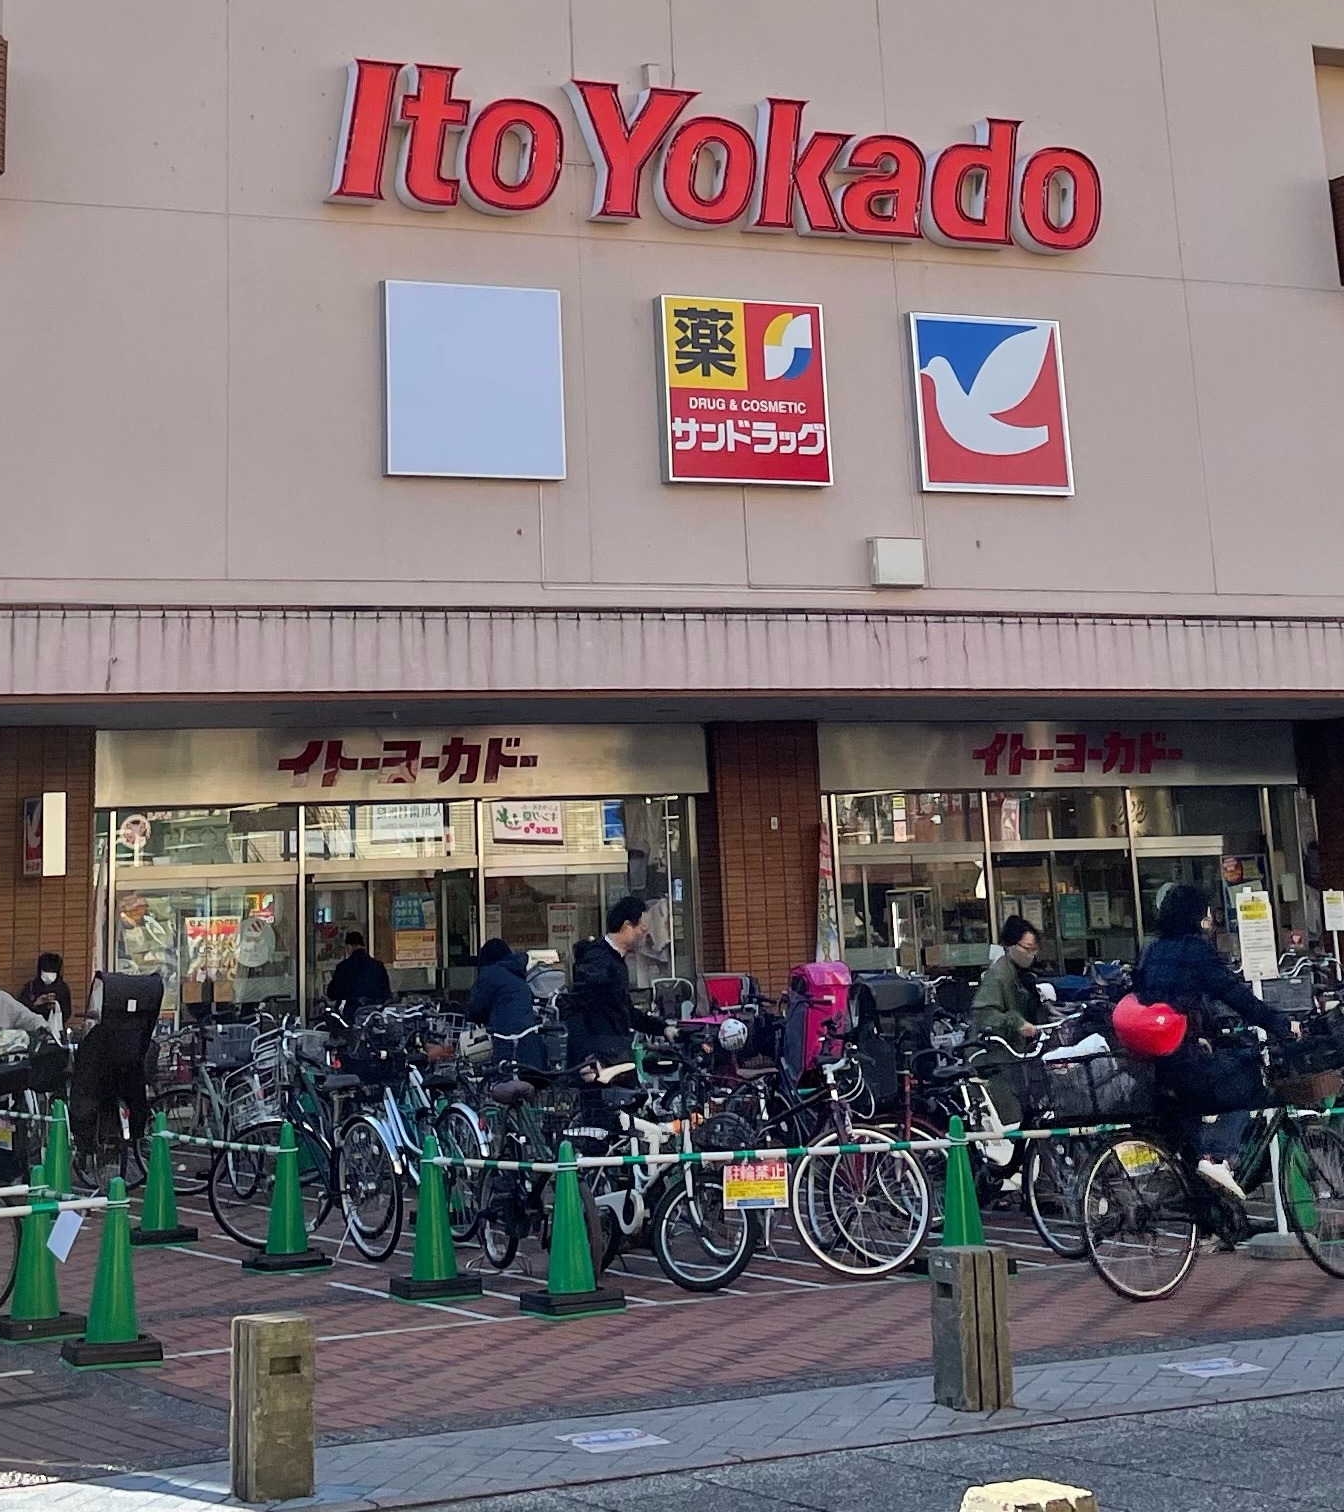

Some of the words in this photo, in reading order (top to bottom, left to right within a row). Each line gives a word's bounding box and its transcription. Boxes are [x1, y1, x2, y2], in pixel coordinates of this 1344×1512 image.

[674, 307, 736, 377] 薬
[689, 397, 726, 411] DRUG
[729, 399, 738, 411] &
[741, 399, 807, 414] COSMETIC
[672, 417, 825, 456] サンドラッグ
[278, 737, 538, 787] イトーヨーカドー
[973, 733, 1182, 775] イトーヨーカドー
[725, 1163, 787, 1182] 駐輪禁止
